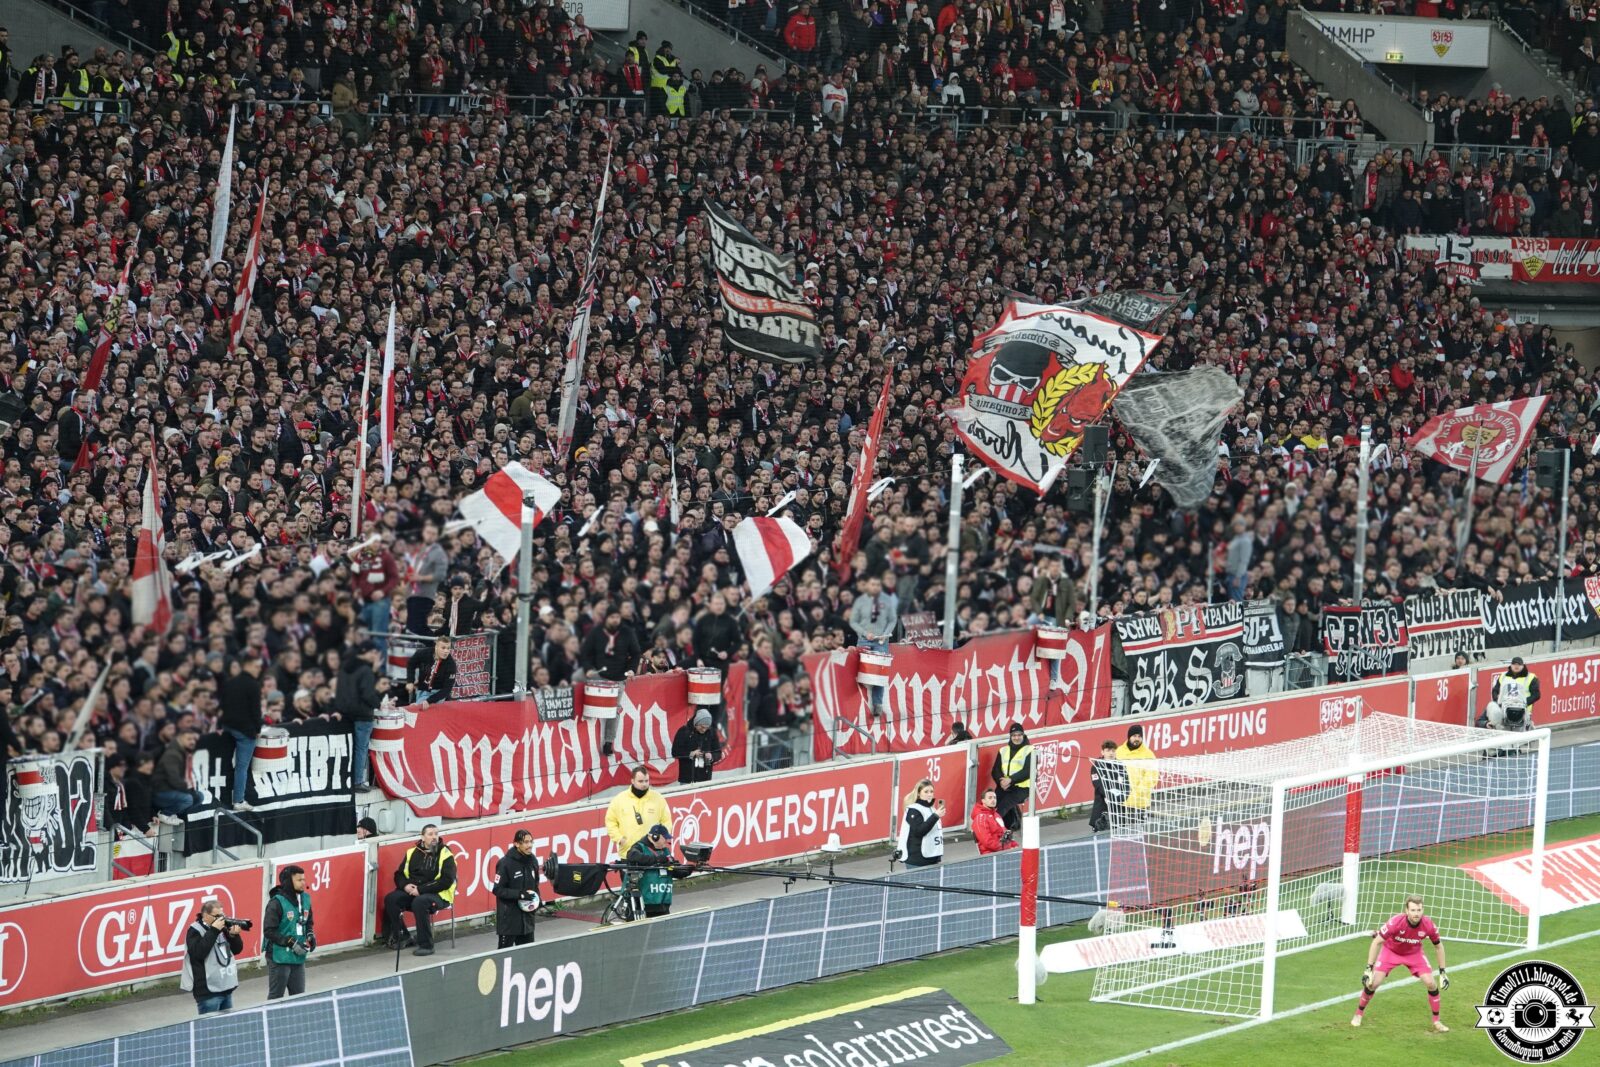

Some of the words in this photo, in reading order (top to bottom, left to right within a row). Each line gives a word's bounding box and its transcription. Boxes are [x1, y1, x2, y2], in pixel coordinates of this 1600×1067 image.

[1338, 27, 1376, 44] MHP
[1435, 236, 1474, 266] 15
[1116, 616, 1163, 641] SCHWA
[1410, 627, 1485, 660] STUTTGART
[1552, 658, 1600, 688] VfB-ST
[1436, 678, 1449, 701] 36
[1550, 691, 1596, 715] Brustring
[1142, 708, 1268, 751] VfB-STIFTUNG
[926, 756, 941, 783] 35
[711, 782, 870, 850] JOKERSTAR
[1213, 816, 1271, 880] hep
[311, 860, 331, 891] 34
[500, 956, 583, 1033] hep
